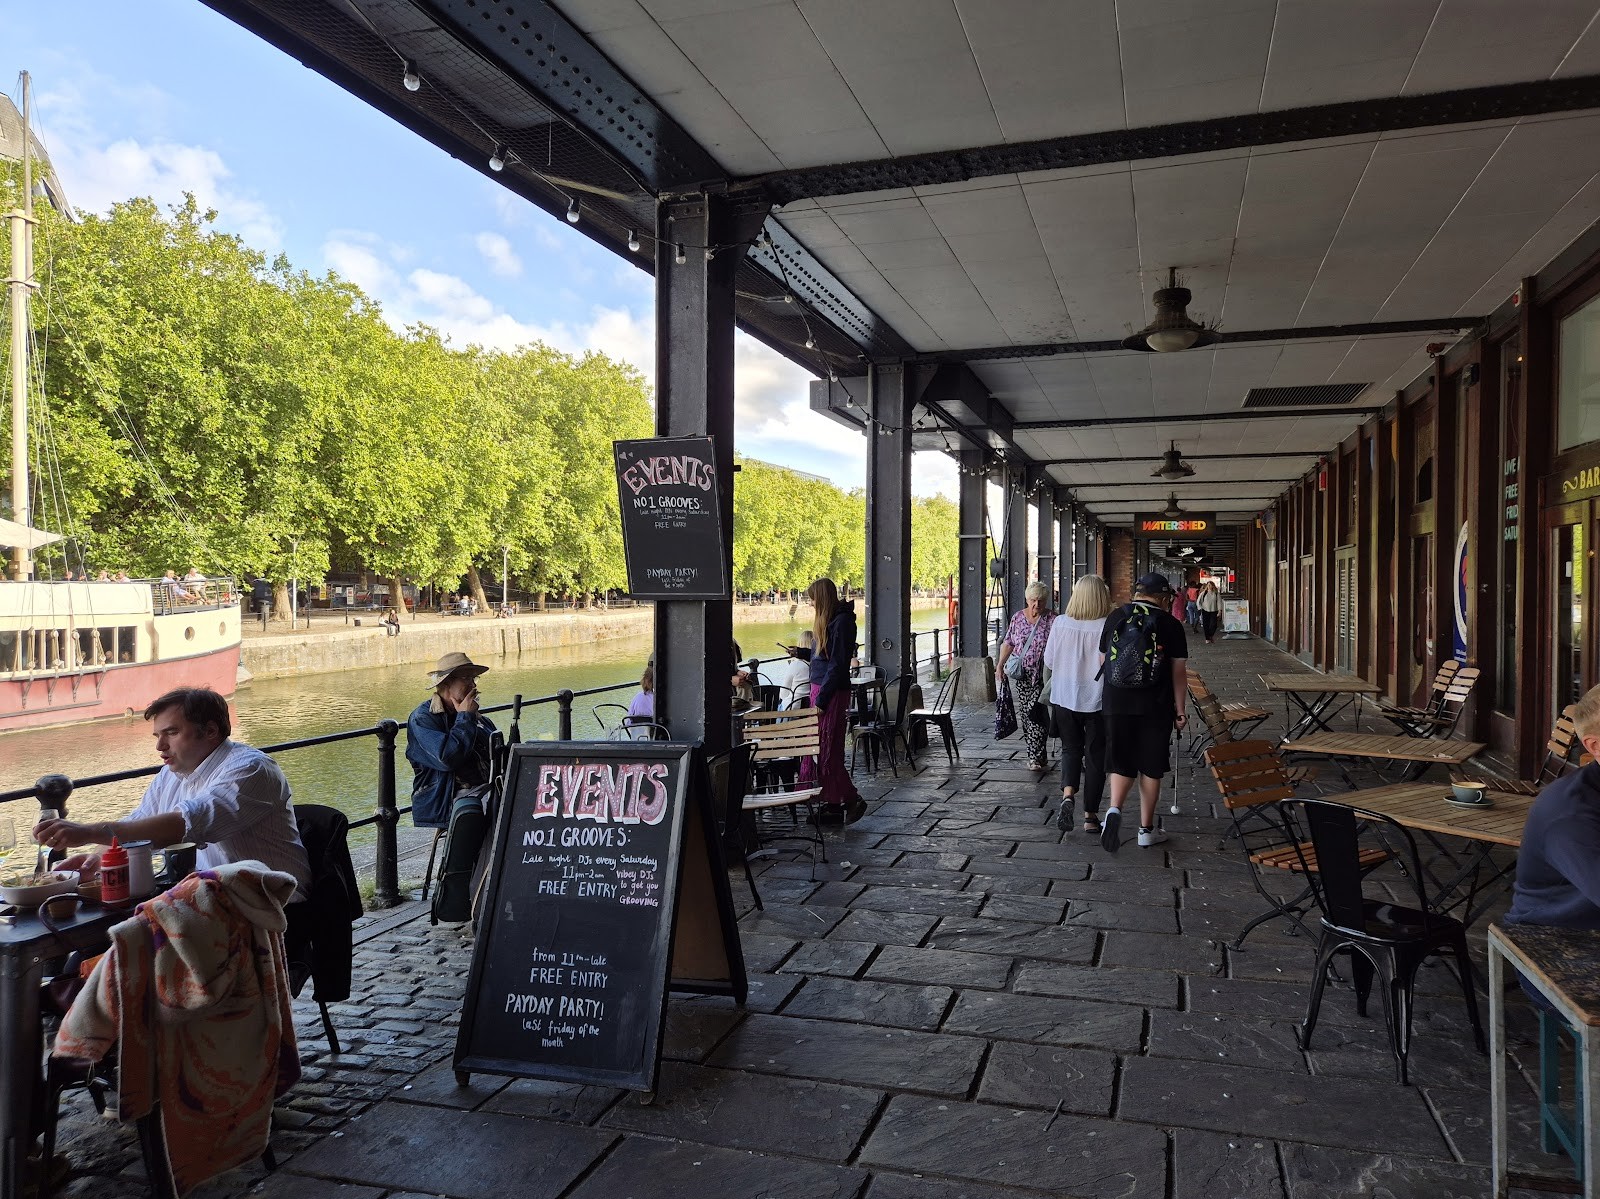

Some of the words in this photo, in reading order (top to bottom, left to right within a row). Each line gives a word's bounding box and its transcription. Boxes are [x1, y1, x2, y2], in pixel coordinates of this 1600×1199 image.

[621, 455, 715, 495] EVENTS
[1504, 458, 1516, 476] LIVE
[1505, 483, 1518, 498] FREE
[658, 496, 703, 510] GROOVES:
[654, 521, 670, 529] FREE
[1142, 520, 1207, 531] WATERSHED
[647, 568, 672, 579] PAYDAY
[674, 567, 699, 578] PARTY!
[532, 762, 669, 826] EVENTS
[560, 827, 632, 847] GROOVES:
[522, 851, 544, 864] Late
[548, 855, 571, 867] night
[578, 855, 592, 865] DJs
[595, 857, 617, 871] every
[619, 853, 658, 872] Saturday
[639, 869, 654, 881] DJs
[538, 880, 568, 895] FREE
[577, 881, 618, 899] ENTRY
[620, 880, 627, 889] to
[631, 881, 644, 895] get
[646, 882, 659, 896] you
[619, 895, 659, 908] GROOVING
[532, 947, 556, 962] from
[529, 967, 564, 985] FREE
[570, 970, 608, 989] ENTRY
[504, 993, 554, 1015] PAYDAY
[558, 995, 604, 1021] PARTY!
[547, 1020, 576, 1040] friday
[578, 1022, 588, 1038] of
[588, 1024, 600, 1036] the
[541, 1037, 564, 1048] month
